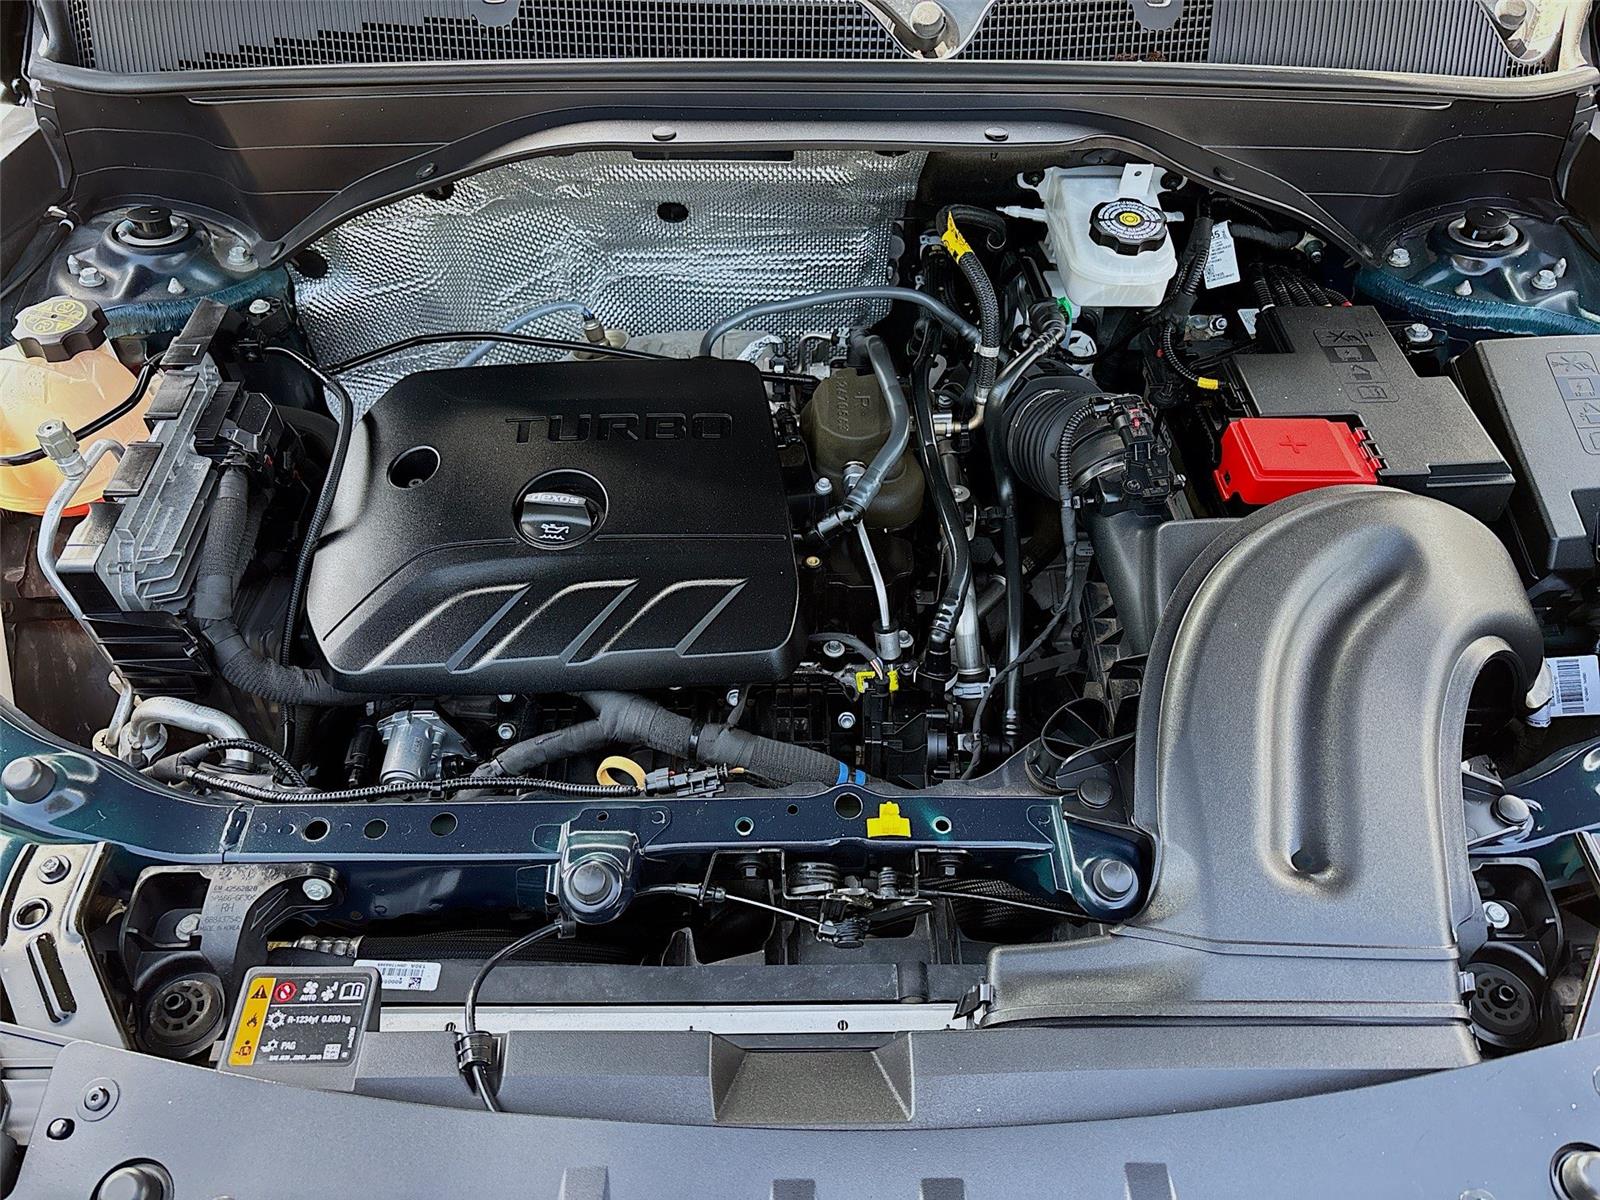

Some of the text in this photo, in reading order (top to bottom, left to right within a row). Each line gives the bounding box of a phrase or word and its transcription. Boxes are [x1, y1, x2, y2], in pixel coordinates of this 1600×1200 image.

[505, 412, 733, 444] TURBO
[530, 492, 580, 505] dexos
[220, 902, 236, 912] RH
[299, 994, 317, 1002] AUTO
[342, 1014, 352, 1025] kg
[280, 1041, 297, 1051] PAG
